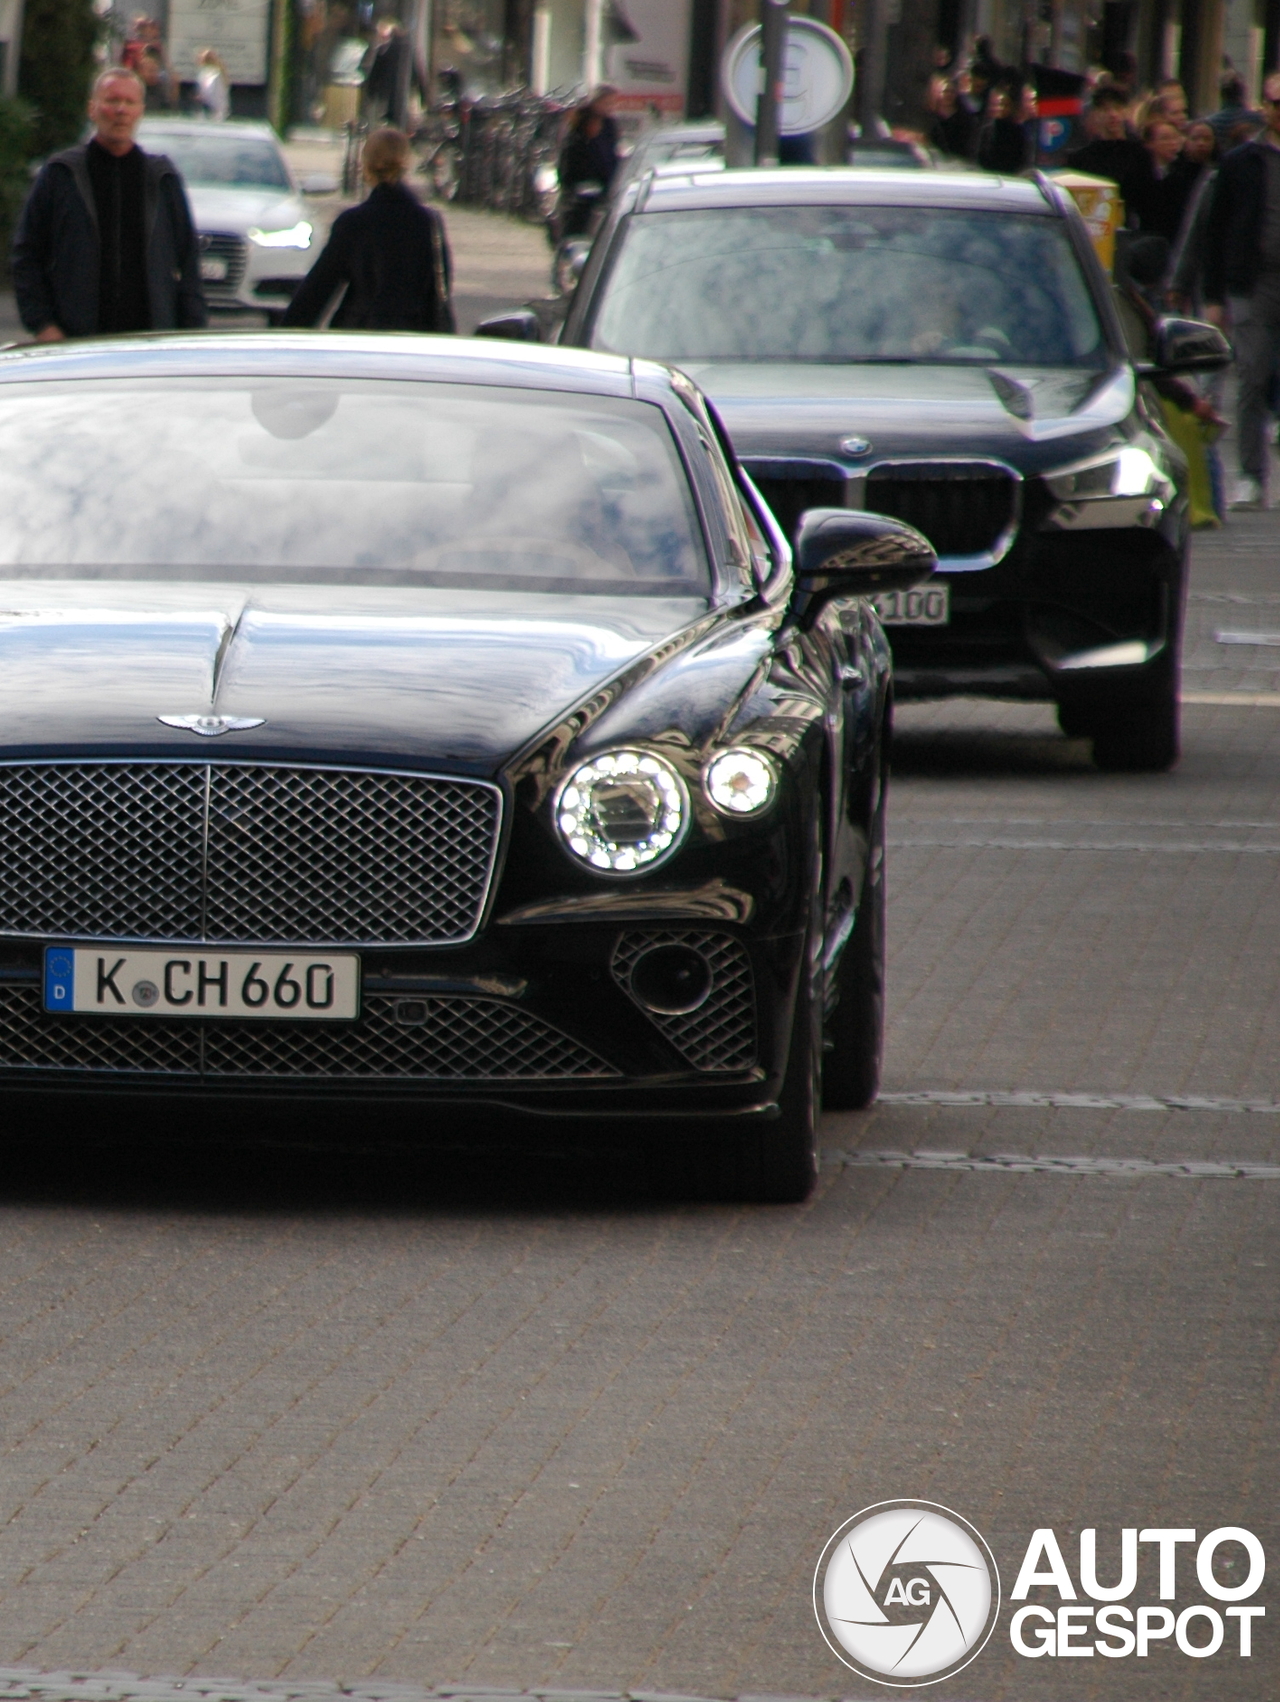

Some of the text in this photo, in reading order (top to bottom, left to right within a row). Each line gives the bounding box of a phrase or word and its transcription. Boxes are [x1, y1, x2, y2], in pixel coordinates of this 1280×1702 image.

[53, 985, 66, 999] D
[96, 957, 335, 1010] K CH 660
